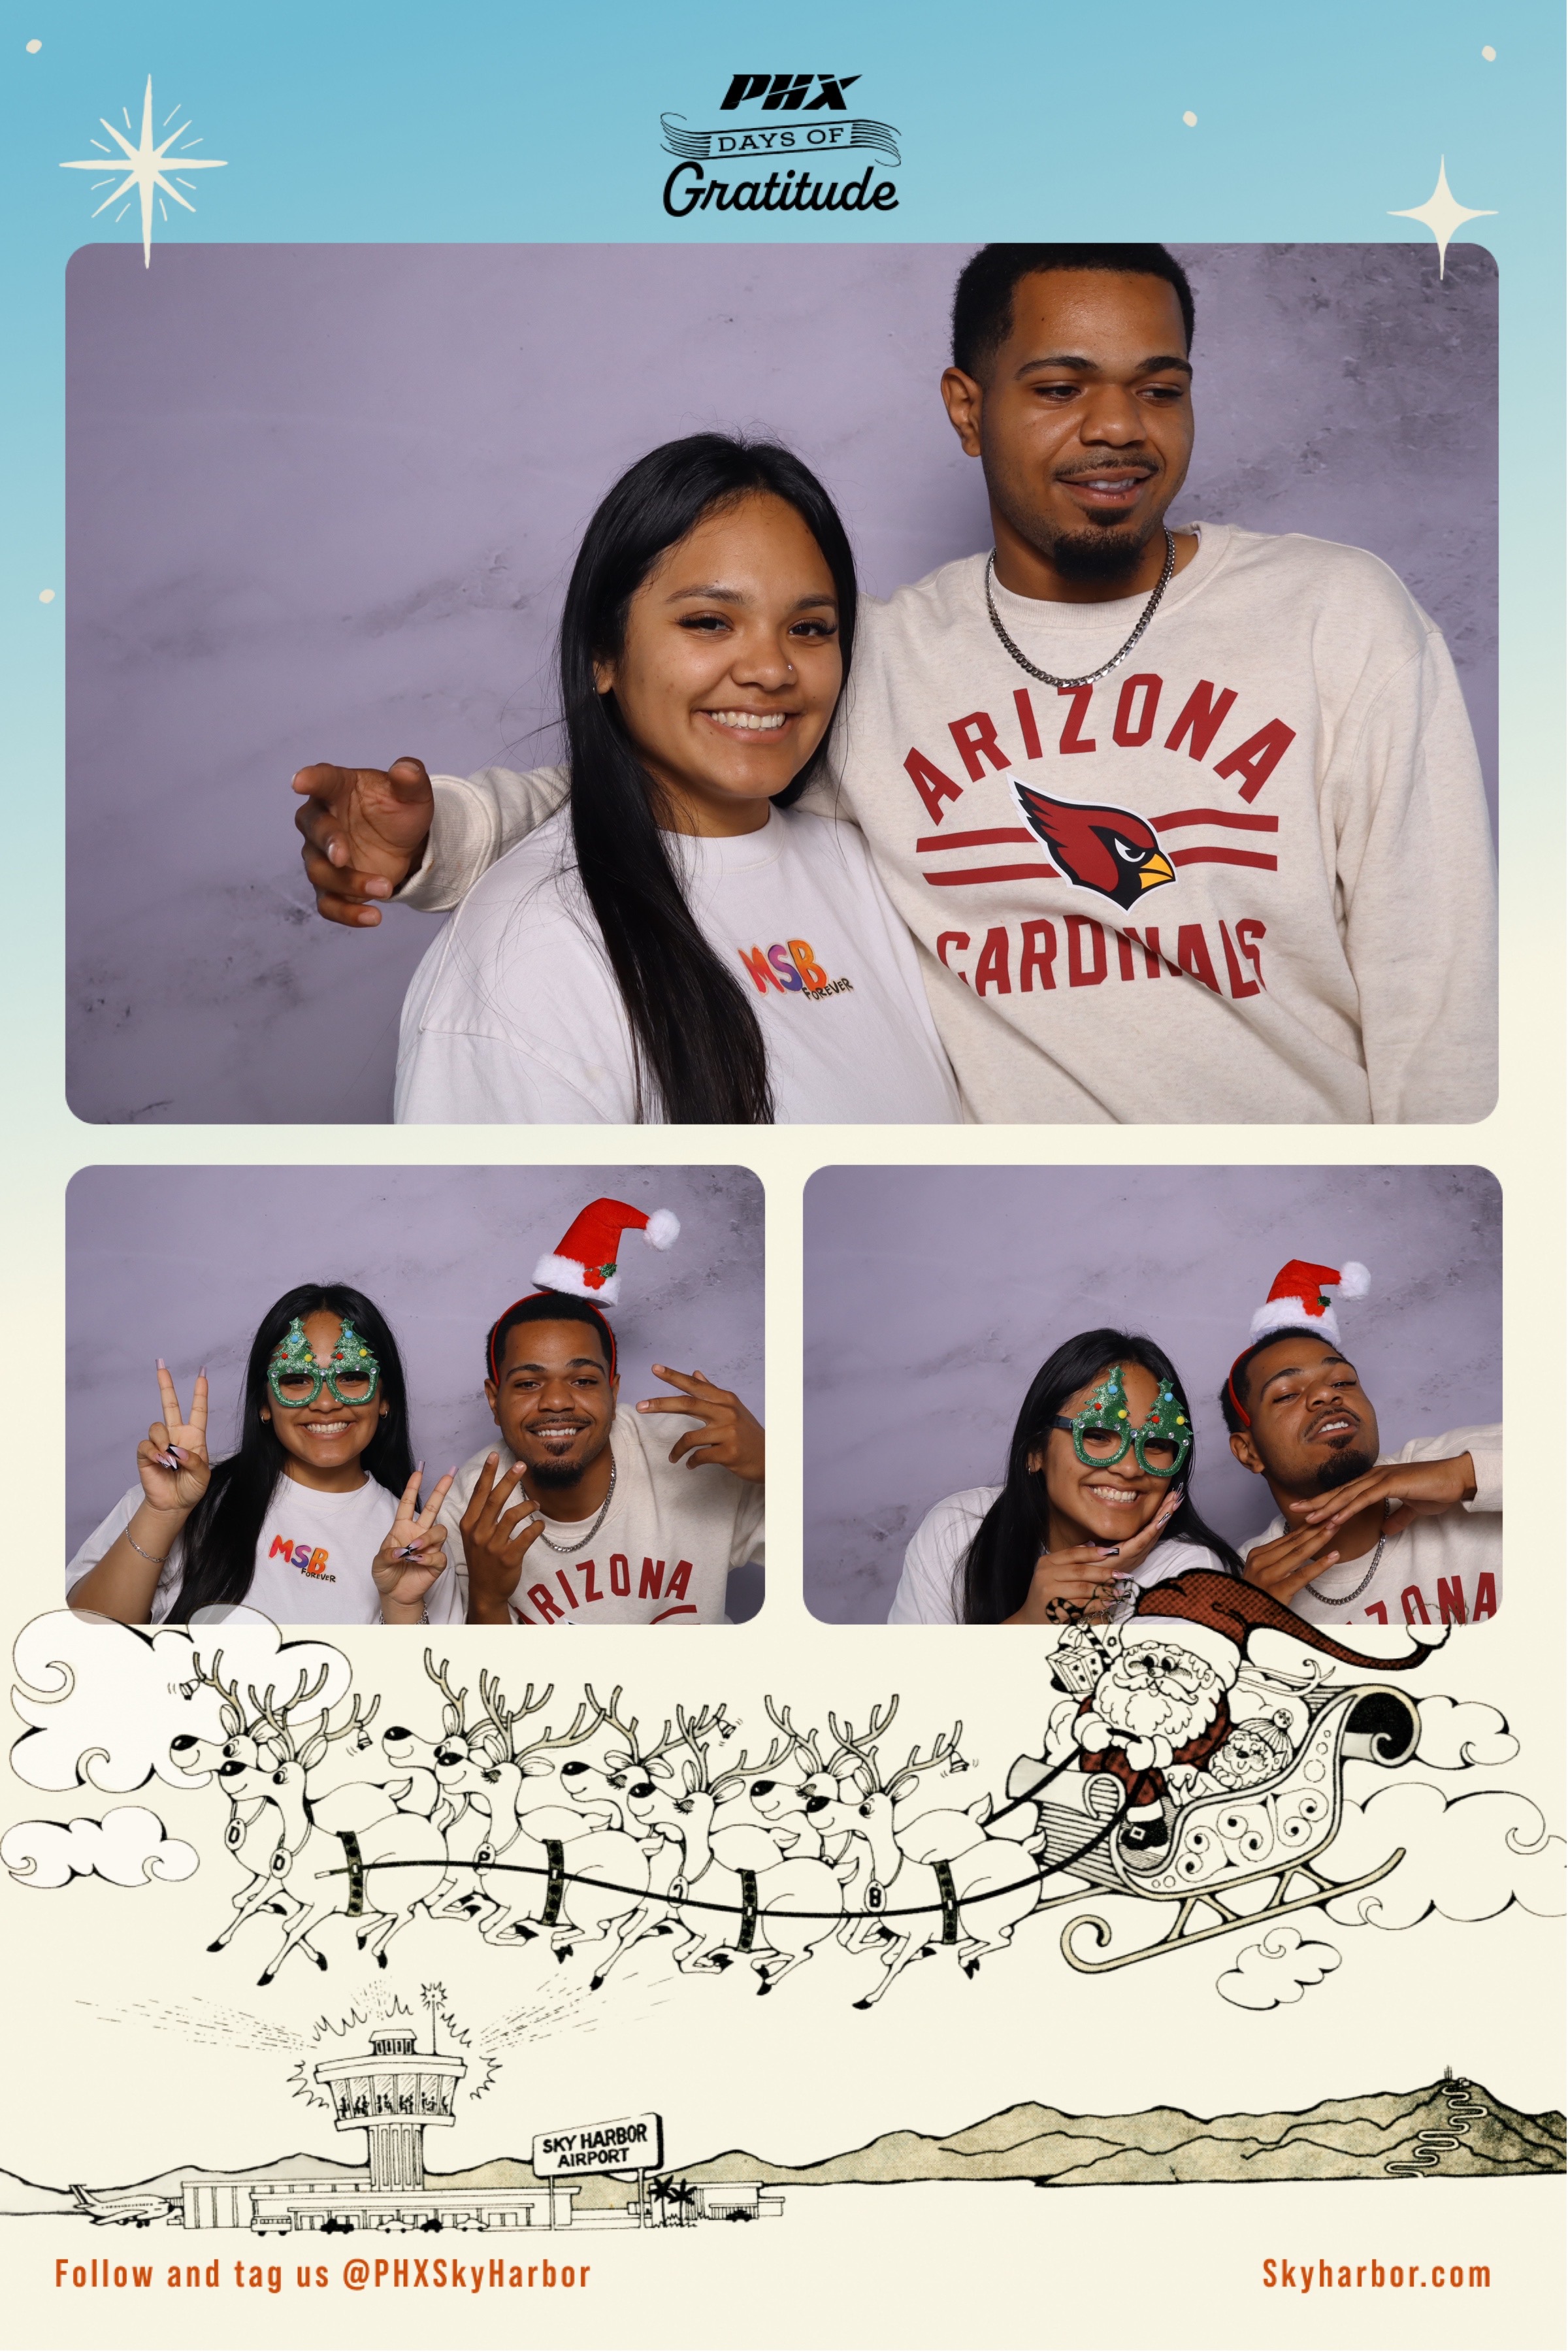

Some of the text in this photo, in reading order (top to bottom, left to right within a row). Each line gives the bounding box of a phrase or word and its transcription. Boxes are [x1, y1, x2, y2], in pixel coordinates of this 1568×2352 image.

[903, 673, 1297, 826] ARIZONA
[738, 939, 827, 994] MSB
[801, 977, 854, 1000] FOREVER
[269, 1535, 329, 1575] MSB
[301, 1567, 336, 1583] FOREVER
